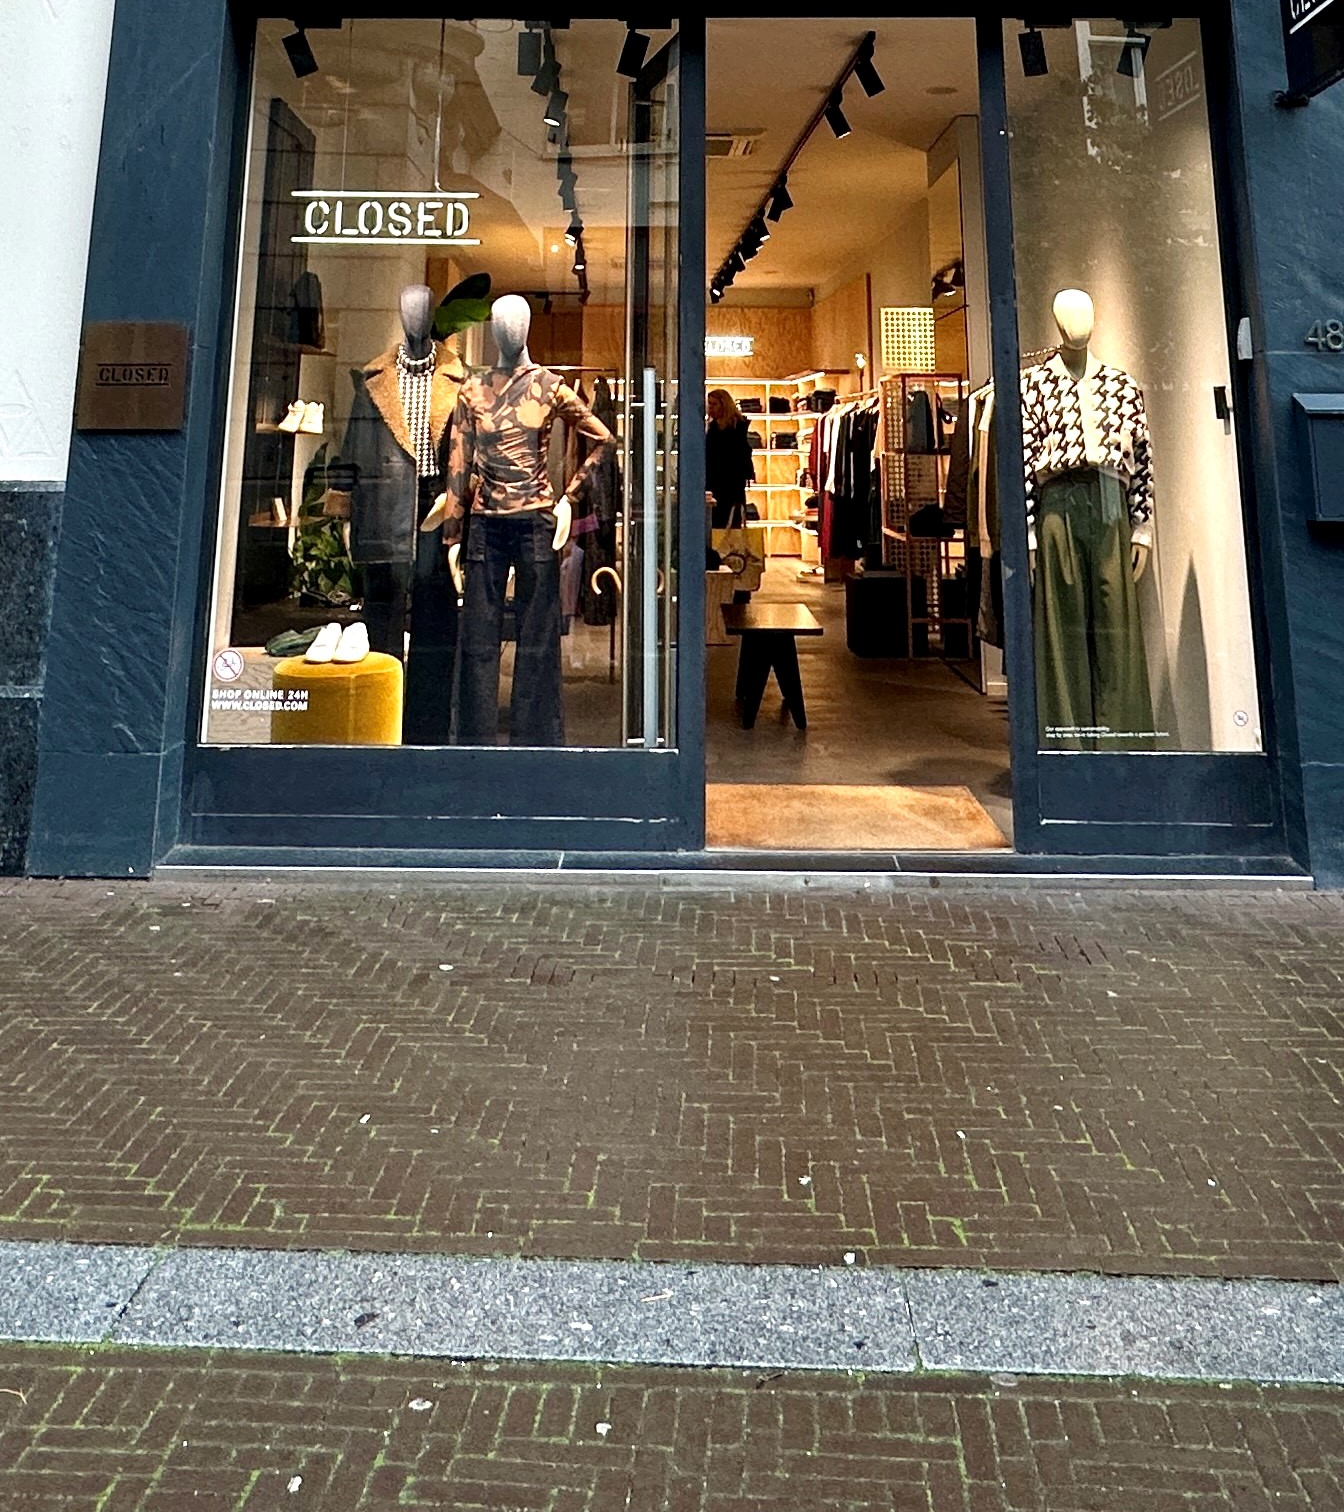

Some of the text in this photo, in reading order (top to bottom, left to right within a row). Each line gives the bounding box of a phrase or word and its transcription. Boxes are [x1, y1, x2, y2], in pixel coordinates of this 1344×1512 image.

[305, 200, 469, 236] CLOSED
[99, 368, 169, 382] CLOSED
[212, 690, 309, 699] SHOP ONLINE 24H
[212, 701, 308, 711] WWW.CLOSED.COM
